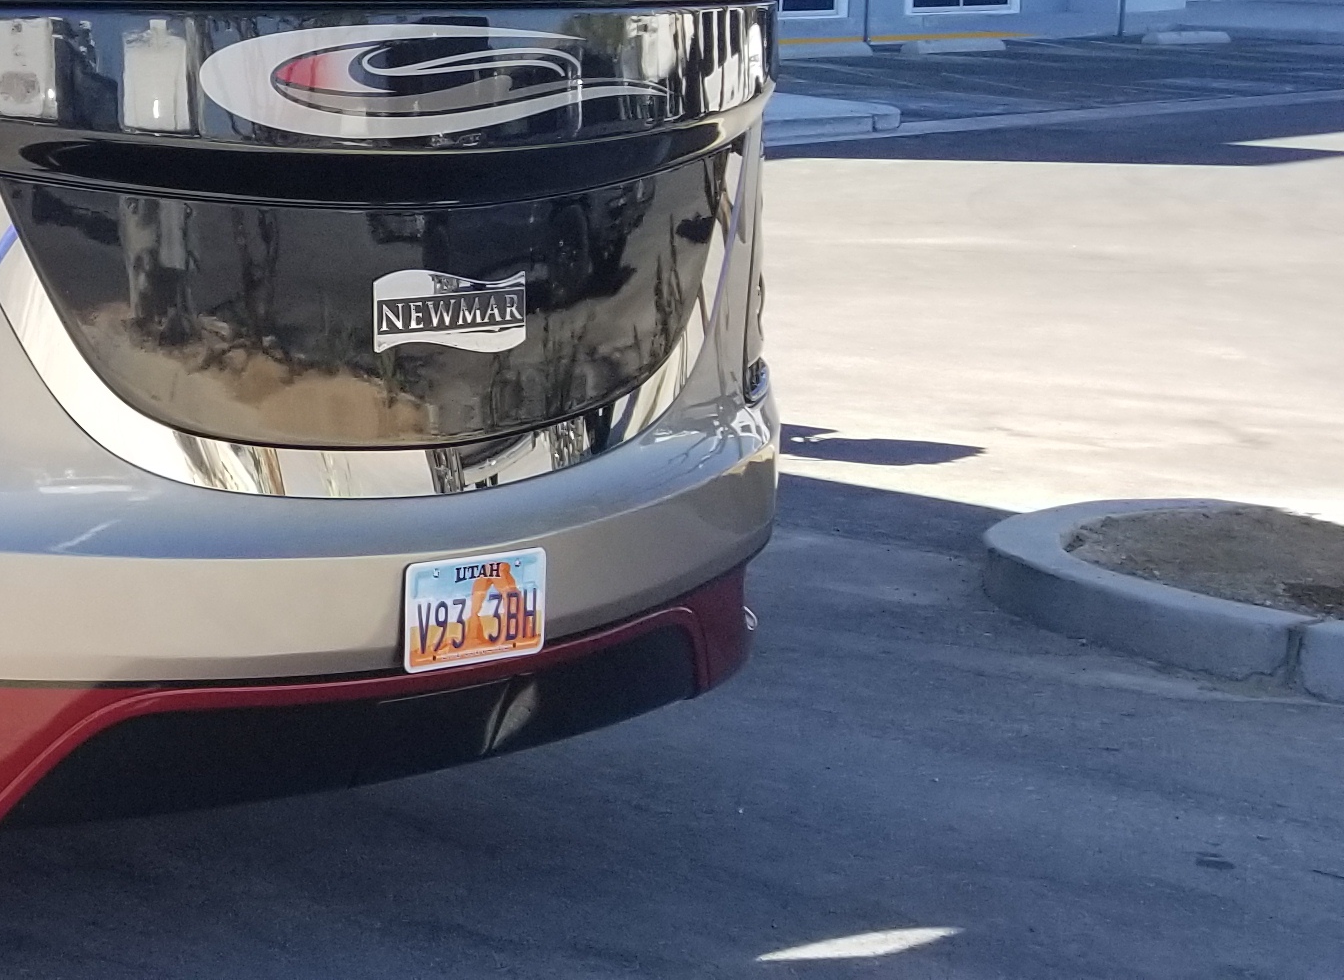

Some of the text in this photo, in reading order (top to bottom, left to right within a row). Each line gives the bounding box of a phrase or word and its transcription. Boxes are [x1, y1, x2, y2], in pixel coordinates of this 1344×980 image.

[379, 293, 524, 332] NEWMAR
[454, 562, 501, 584] UTAH
[417, 587, 538, 655] V93 3BH
